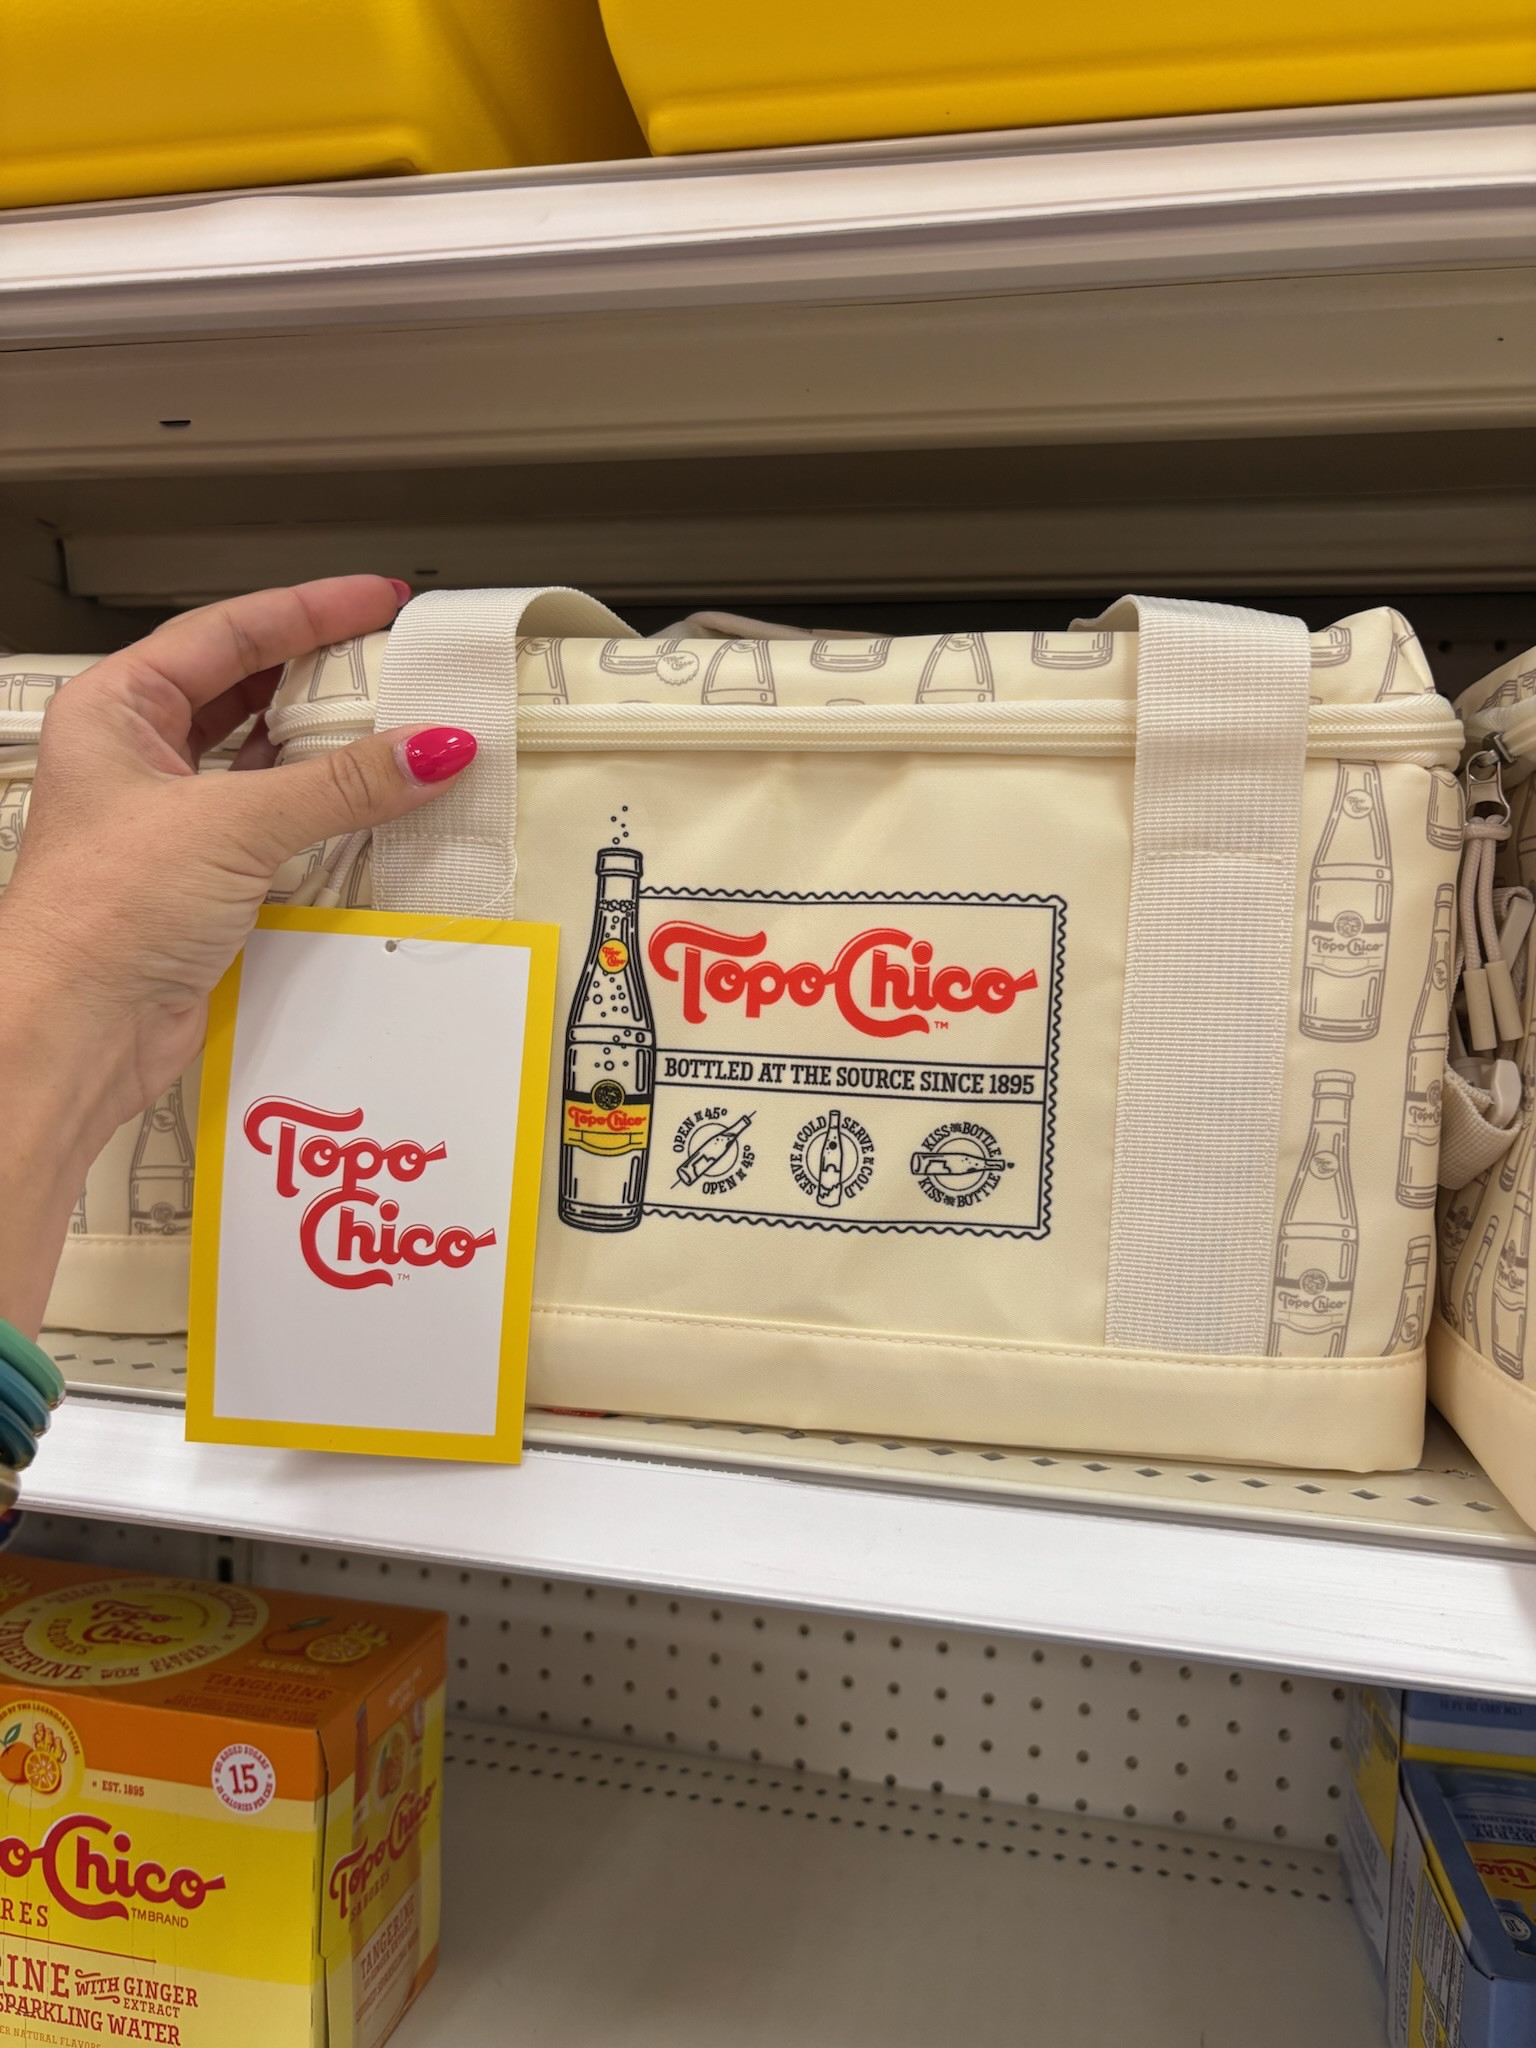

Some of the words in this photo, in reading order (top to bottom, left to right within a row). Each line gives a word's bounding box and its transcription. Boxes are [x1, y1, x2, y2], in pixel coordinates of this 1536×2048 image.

[1312, 935, 1347, 953] Topo
[1347, 938, 1384, 956] Chico
[648, 920, 835, 1025] Topo
[835, 928, 1038, 1038] Chico
[664, 1057, 754, 1082] BOTTLED
[758, 1063, 787, 1084] AT
[790, 1064, 832, 1086] THE
[836, 1067, 915, 1091] SOURCE
[920, 1070, 984, 1094] SINCE
[989, 1074, 1035, 1095] 1895
[568, 1106, 607, 1128] Topo
[606, 1110, 647, 1132] Chico
[797, 1116, 827, 1143] COLD
[244, 1095, 447, 1198] Topo
[673, 1117, 695, 1153] OPEN
[841, 1117, 875, 1154] SERVE
[921, 1124, 951, 1152] KISS
[961, 1121, 1002, 1158] BOTTLE
[702, 1175, 738, 1195] OPEN
[790, 1153, 817, 1196] SERVE
[844, 1166, 873, 1199] COLD
[918, 1176, 945, 1203] KISS
[956, 1172, 1002, 1208] BOTTLE
[300, 1185, 496, 1290] Chico
[397, 1273, 411, 1281] TM
[1278, 1292, 1312, 1310] Topo
[1312, 1295, 1347, 1313] Chico
[91, 1599, 183, 1628] Topo
[82, 1620, 184, 1646] Chico
[0, 1618, 91, 1680] TANGERINE
[206, 1672, 333, 1700] TANGERINE
[17, 1702, 31, 1711] THE
[32, 1703, 69, 1730] LEGENDARY
[69, 1729, 80, 1755] TASTE
[220, 1746, 243, 1761] ADDED
[244, 1746, 270, 1770] SUGARS
[102, 1780, 122, 1794] EST.
[124, 1784, 145, 1797] 1895
[229, 1763, 259, 1794] 15
[221, 1793, 253, 1812] CALORIES
[253, 1796, 267, 1809] PER
[42, 1812, 226, 1921] Chico
[329, 1837, 388, 1920] Topo
[75, 1976, 120, 1997] WITH
[124, 1977, 199, 2008] GINGER
[123, 1997, 181, 2019] EXTRACT
[13, 2027, 58, 2045] NATURAL
[107, 2013, 181, 2046] WATER
